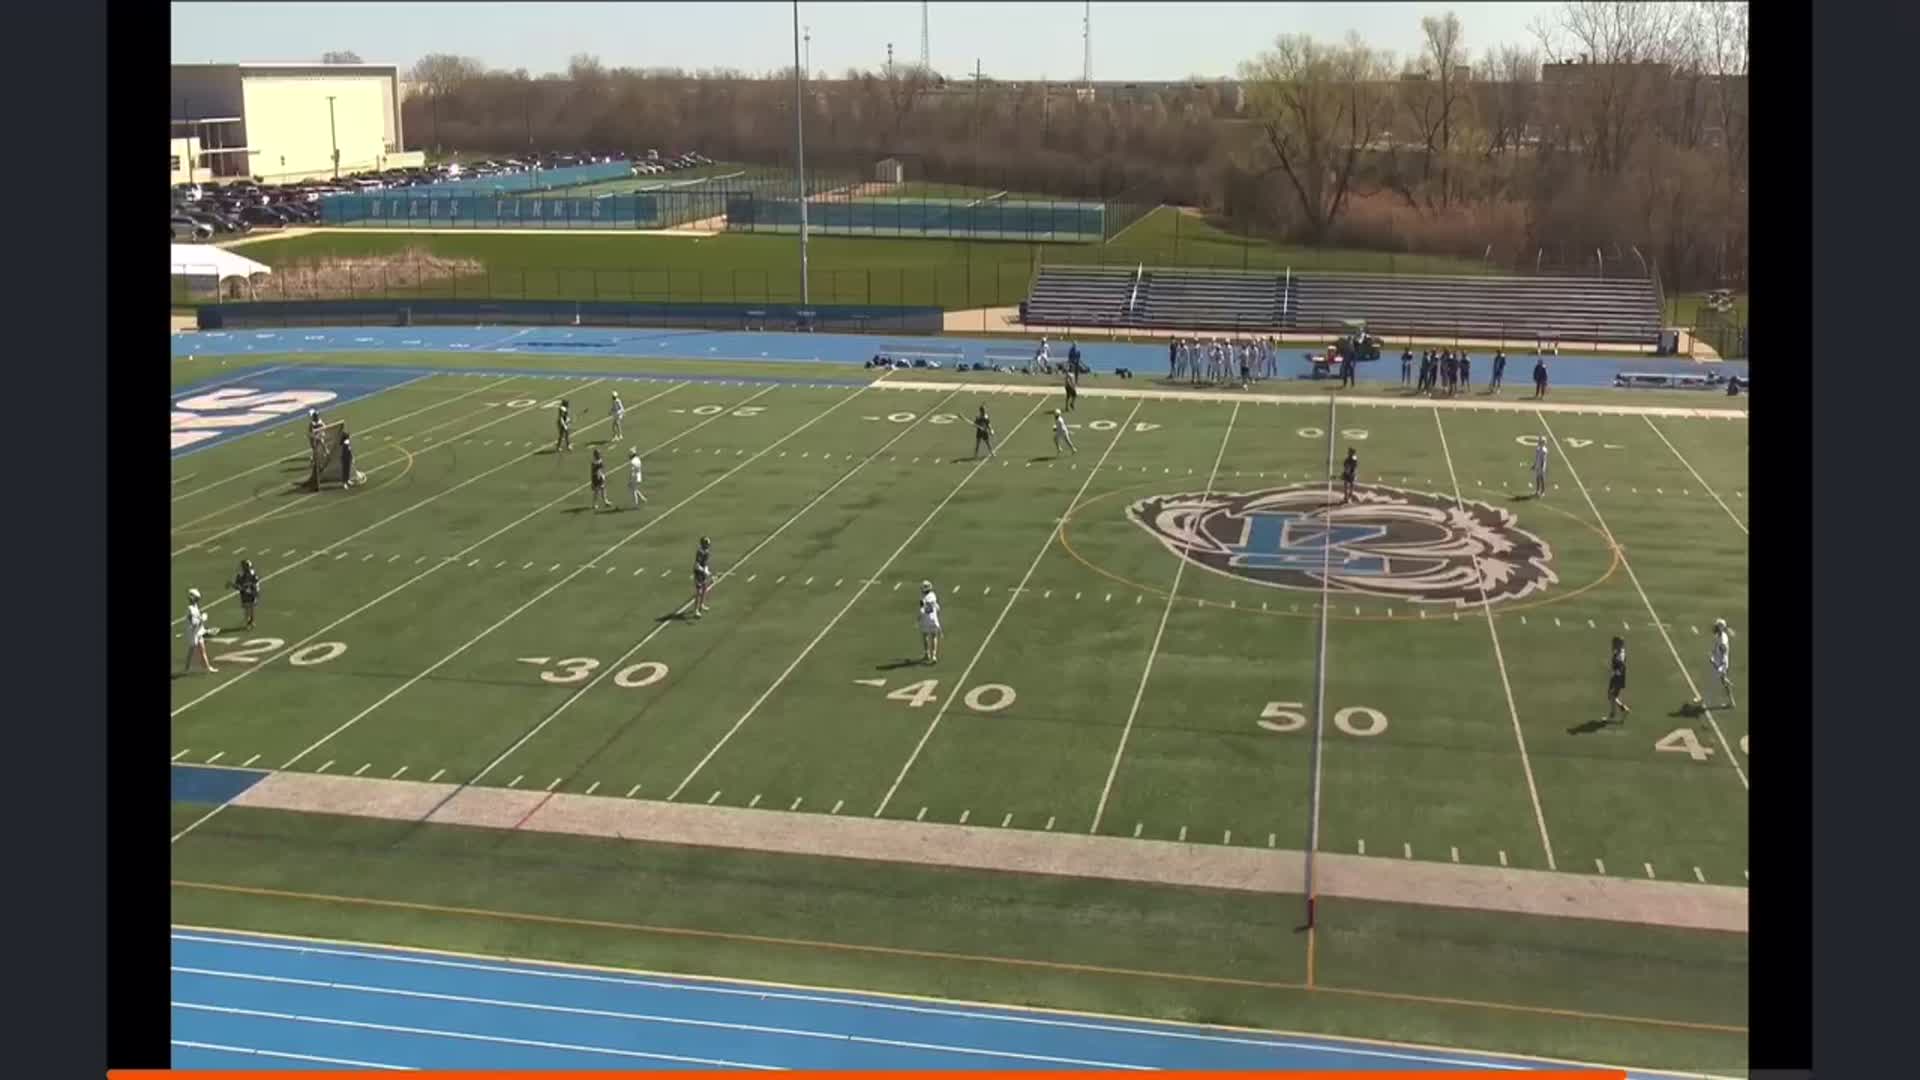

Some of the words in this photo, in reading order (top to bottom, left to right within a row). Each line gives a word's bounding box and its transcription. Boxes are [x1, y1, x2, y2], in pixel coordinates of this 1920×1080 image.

[213, 637, 348, 666] 20
[540, 657, 669, 687] 30
[886, 679, 1017, 711] 40
[1256, 701, 1389, 737] 50
